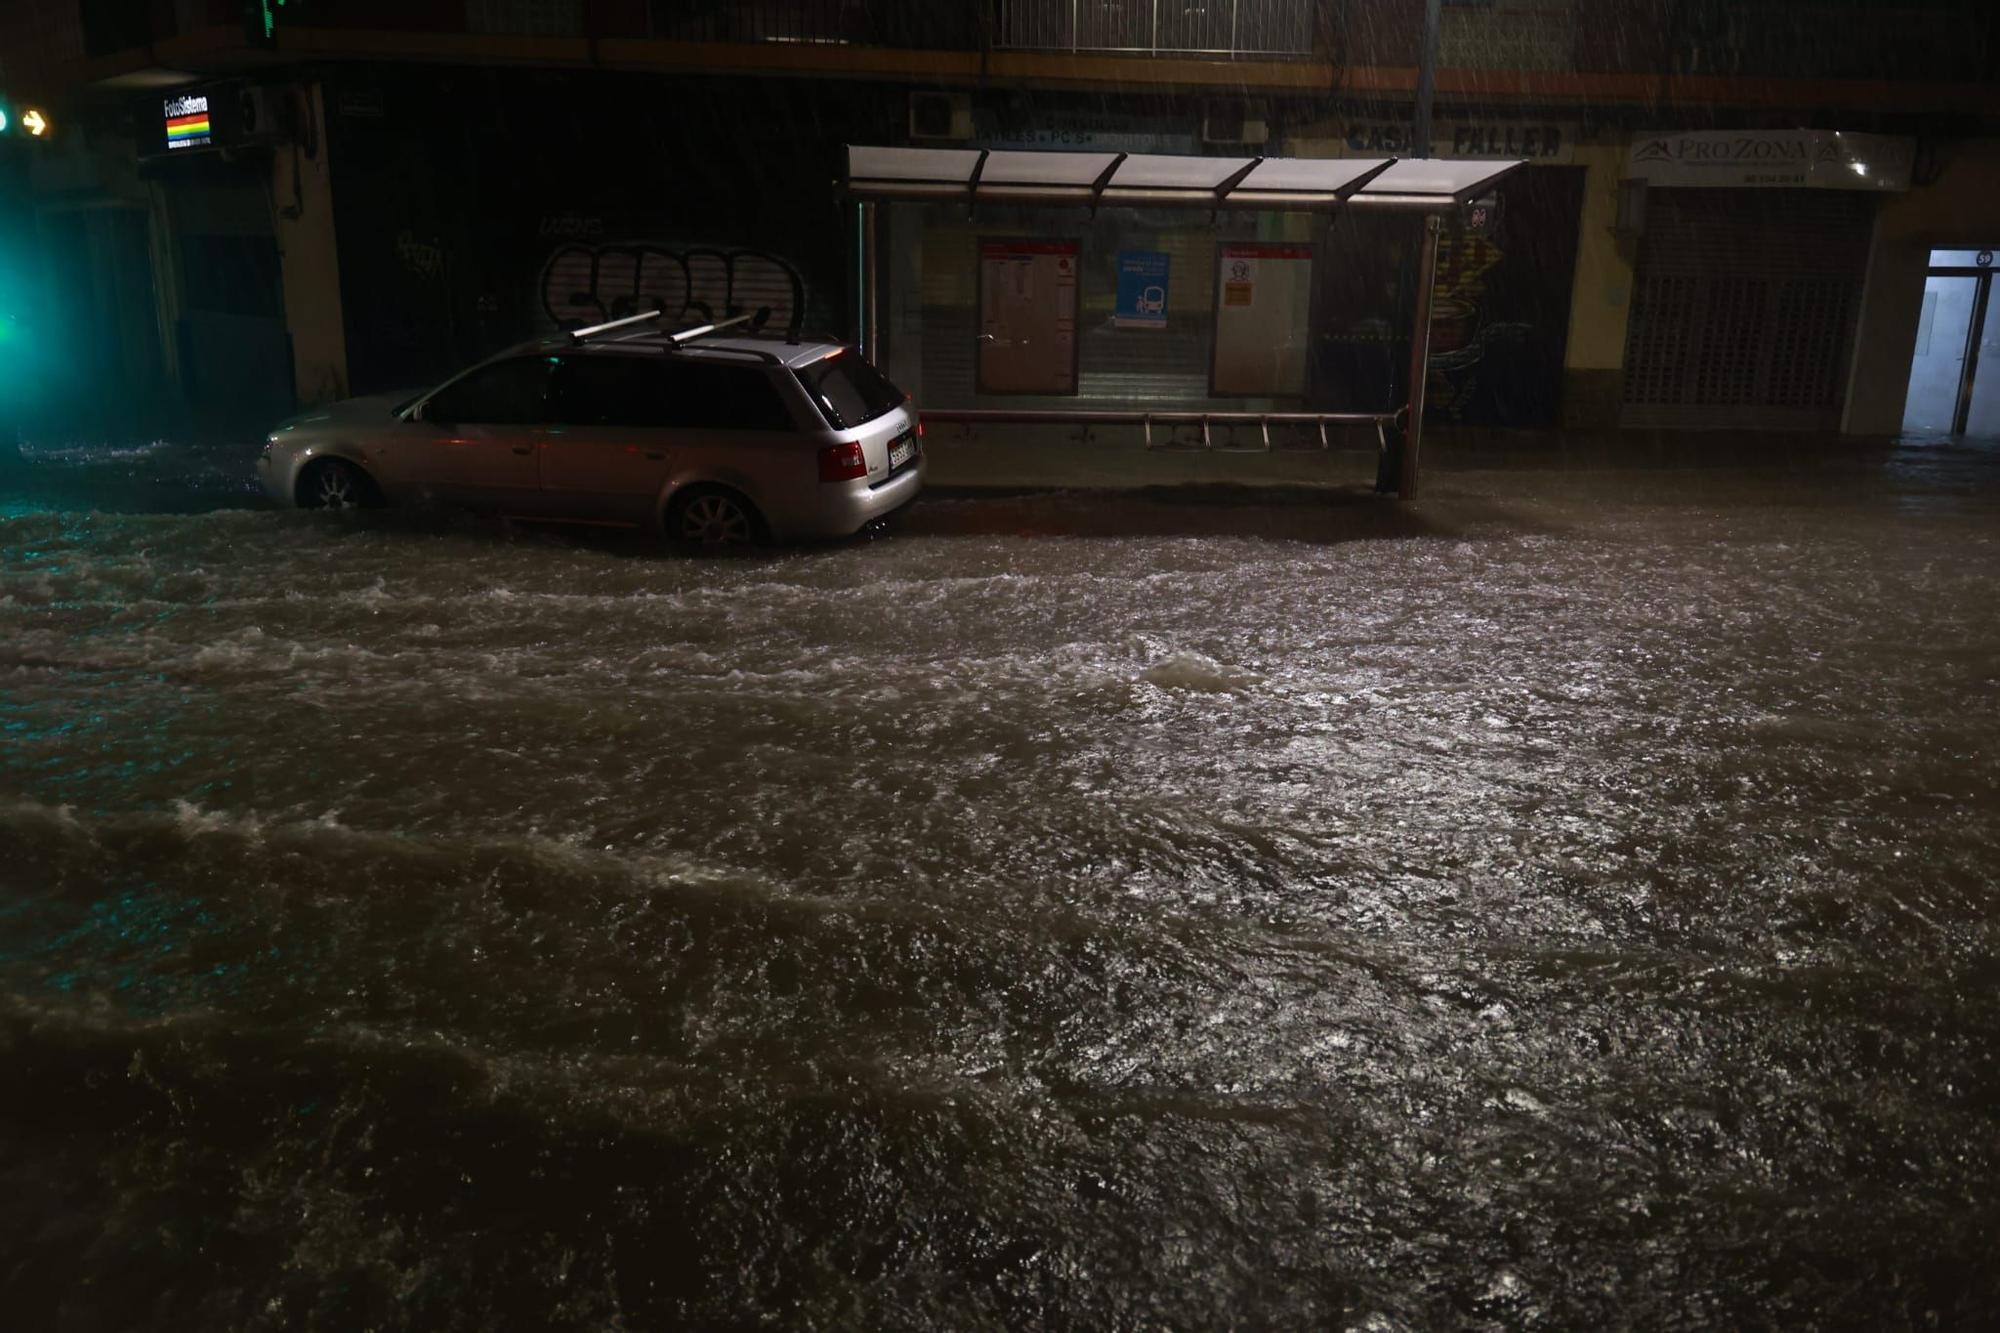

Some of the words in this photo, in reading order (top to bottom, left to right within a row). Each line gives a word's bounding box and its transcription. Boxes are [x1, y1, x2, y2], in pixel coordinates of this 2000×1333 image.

[163, 96, 208, 117] FotoSistema
[1453, 126, 1562, 156] FALLER
[1978, 254, 1991, 265] 59
